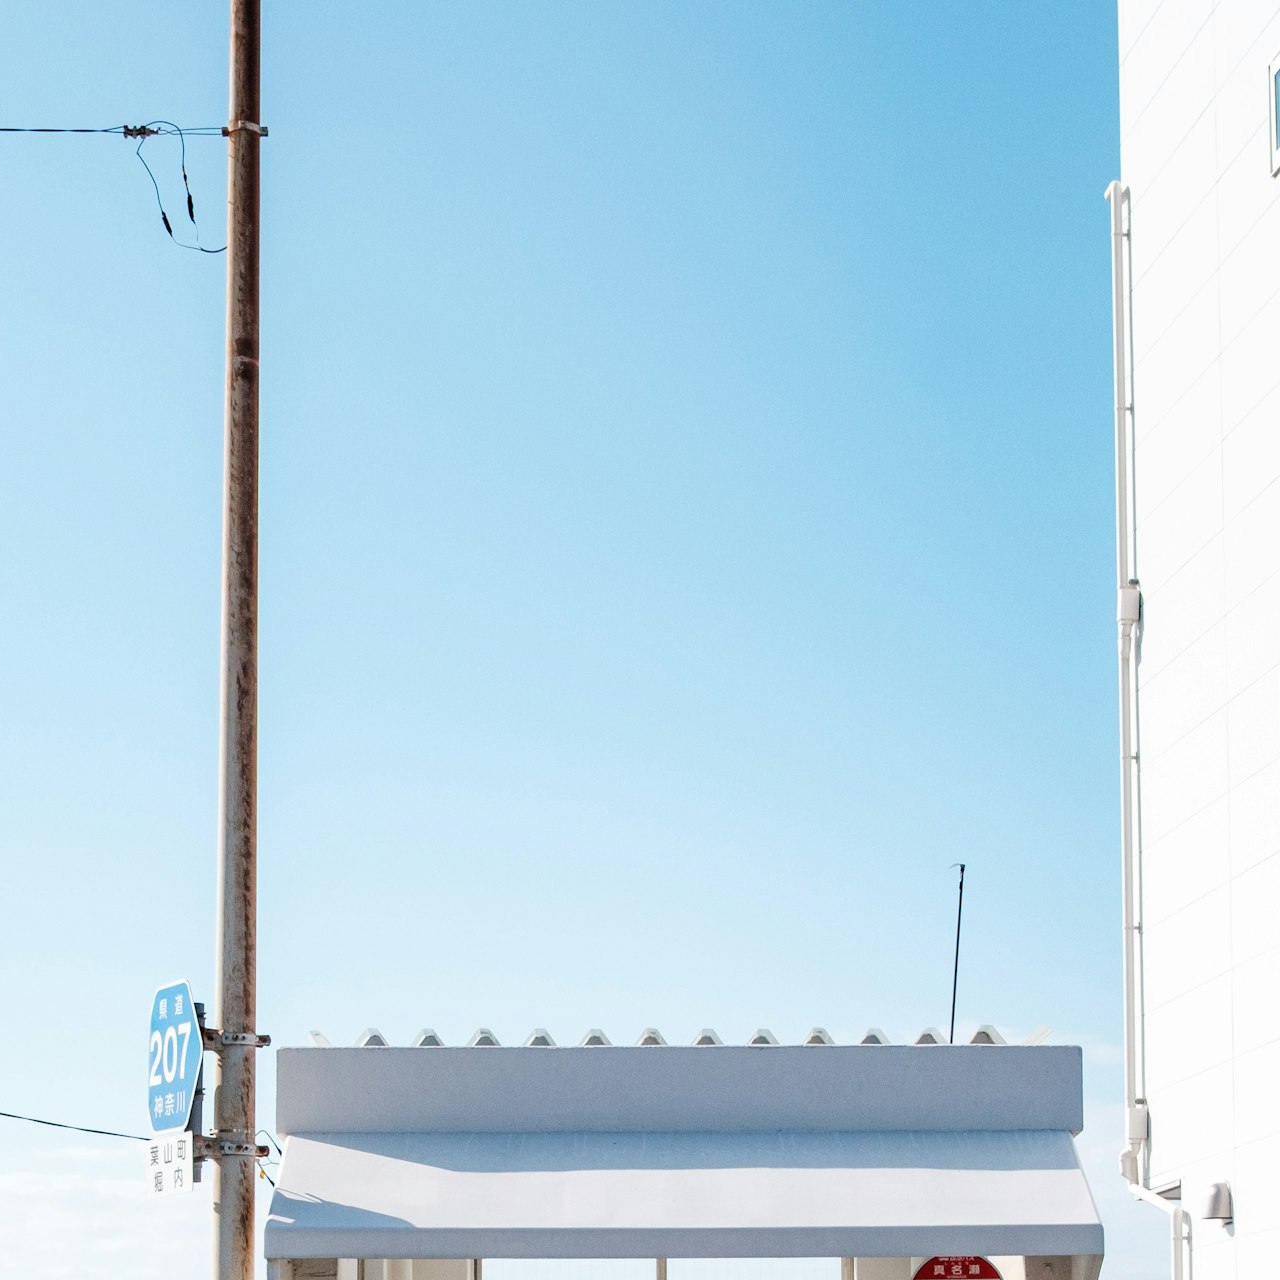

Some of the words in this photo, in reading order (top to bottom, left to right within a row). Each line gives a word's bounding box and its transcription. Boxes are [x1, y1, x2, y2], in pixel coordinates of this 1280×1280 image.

[159, 994, 183, 1019] 県道
[149, 1022, 192, 1087] 207
[154, 1090, 186, 1118] 神奈川
[150, 1140, 186, 1166] 葉山町
[933, 1264, 980, 1275] 真名瀬
